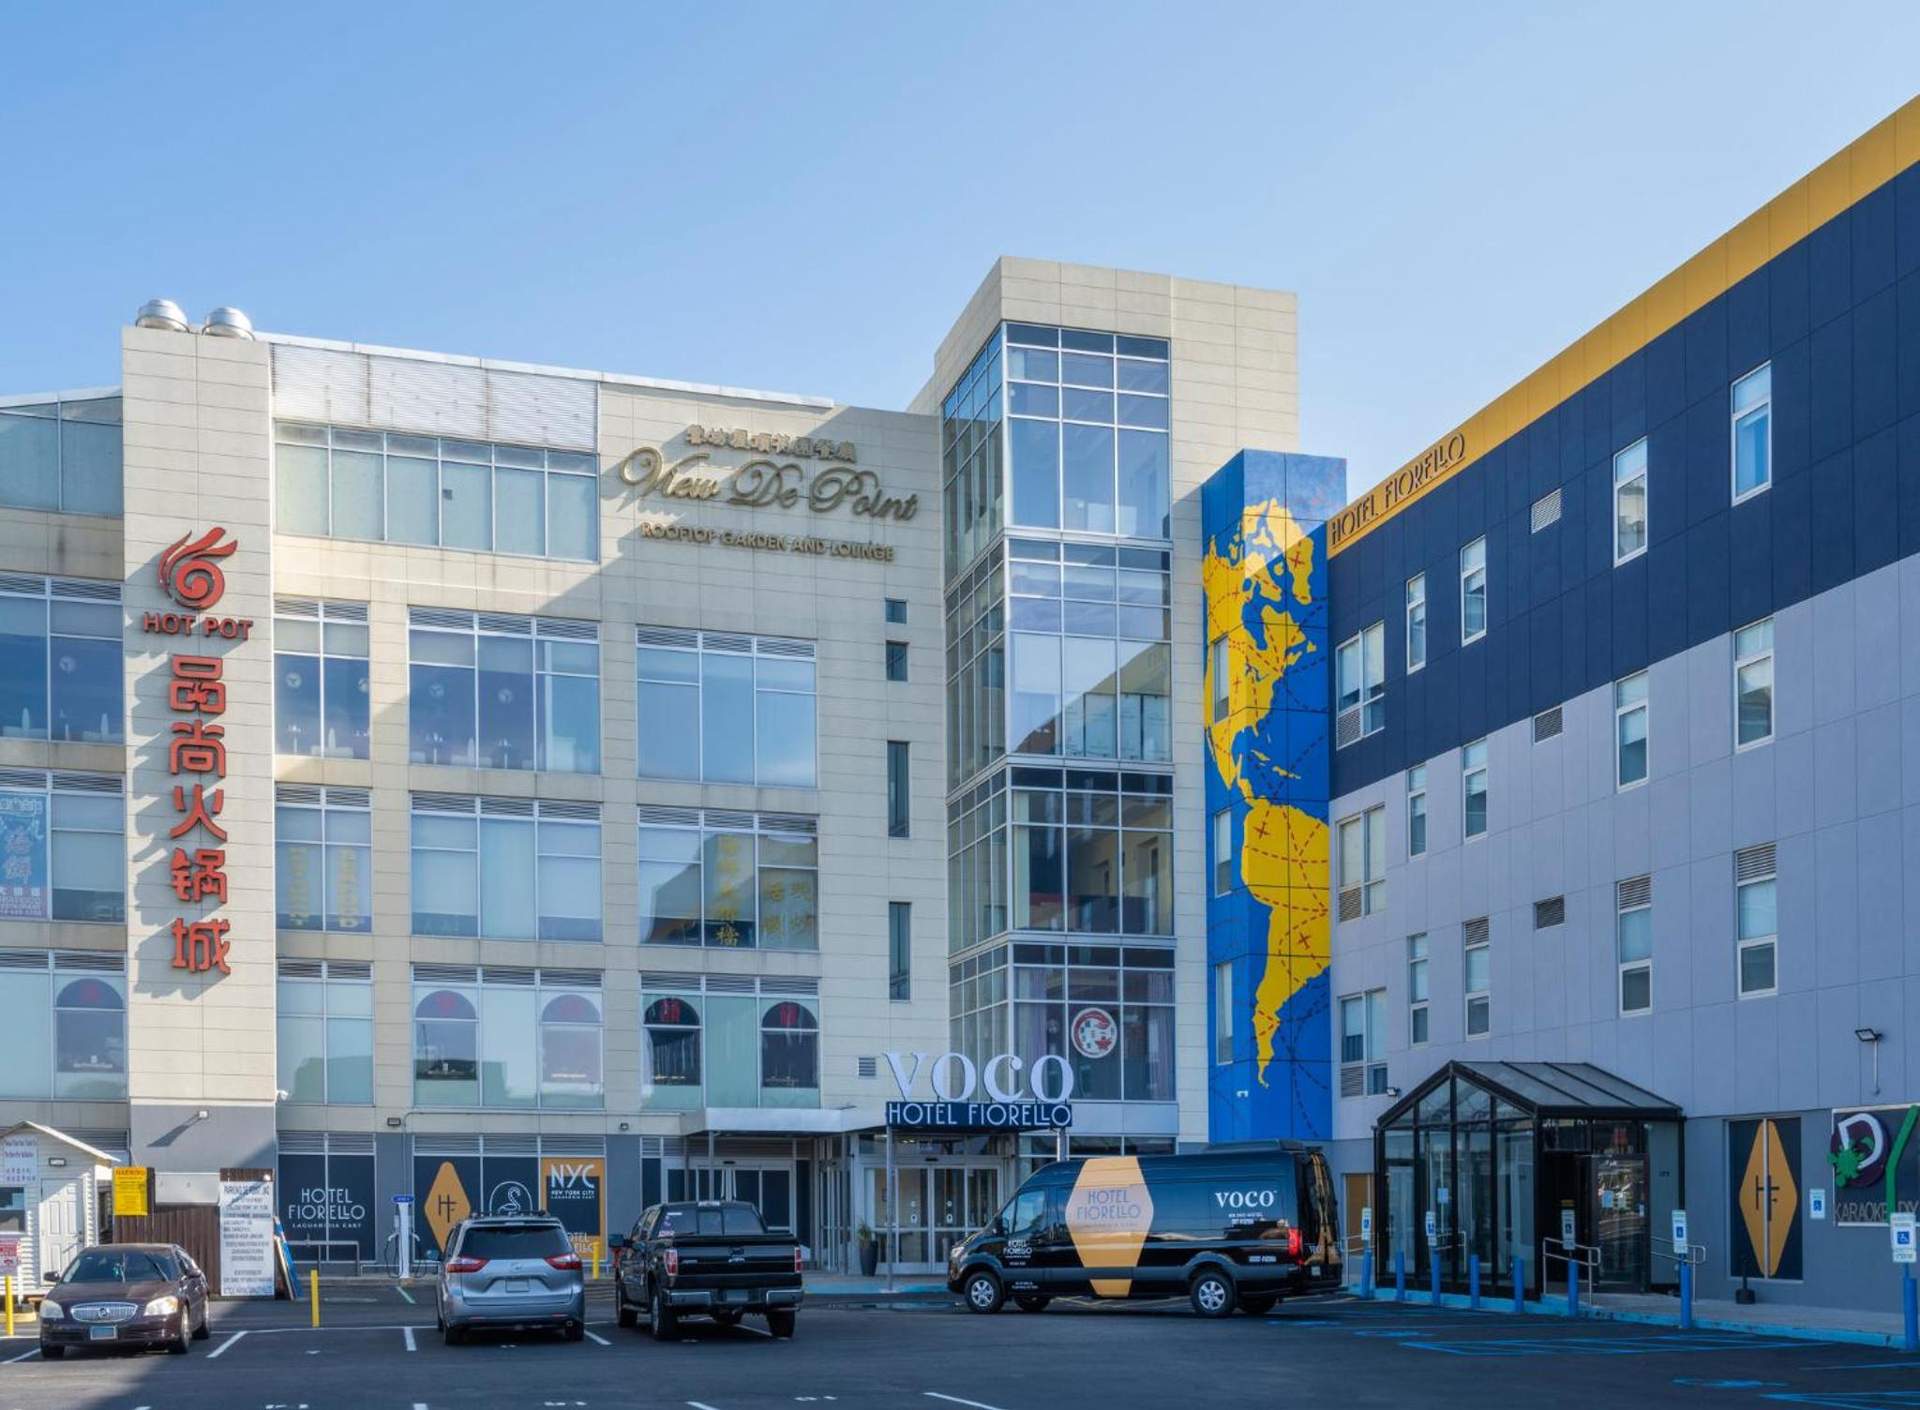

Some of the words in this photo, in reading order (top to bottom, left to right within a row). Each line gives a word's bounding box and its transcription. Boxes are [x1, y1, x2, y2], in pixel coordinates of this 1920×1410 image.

[618, 446, 722, 500] View
[726, 458, 803, 509] De
[808, 466, 919, 522] Point
[1331, 494, 1379, 546] HOTEL
[1384, 432, 1465, 508] FIORELLO
[640, 521, 719, 546] ROOFTOP
[720, 530, 786, 552] GARDEN
[790, 536, 825, 556] AND
[831, 540, 896, 563] LOUNGE
[143, 611, 198, 637] HOT
[203, 616, 254, 641] POT
[888, 1103, 957, 1125] HOTEL
[968, 1103, 1071, 1126] FIORELLO
[551, 1164, 595, 1189] NYC
[301, 1188, 353, 1203] HOTEL
[1088, 1189, 1131, 1204] HOTEL
[288, 1204, 366, 1220] FIORELLO
[1077, 1205, 1142, 1220] FIORELLO
[1834, 1201, 1888, 1223] KARAOKE
